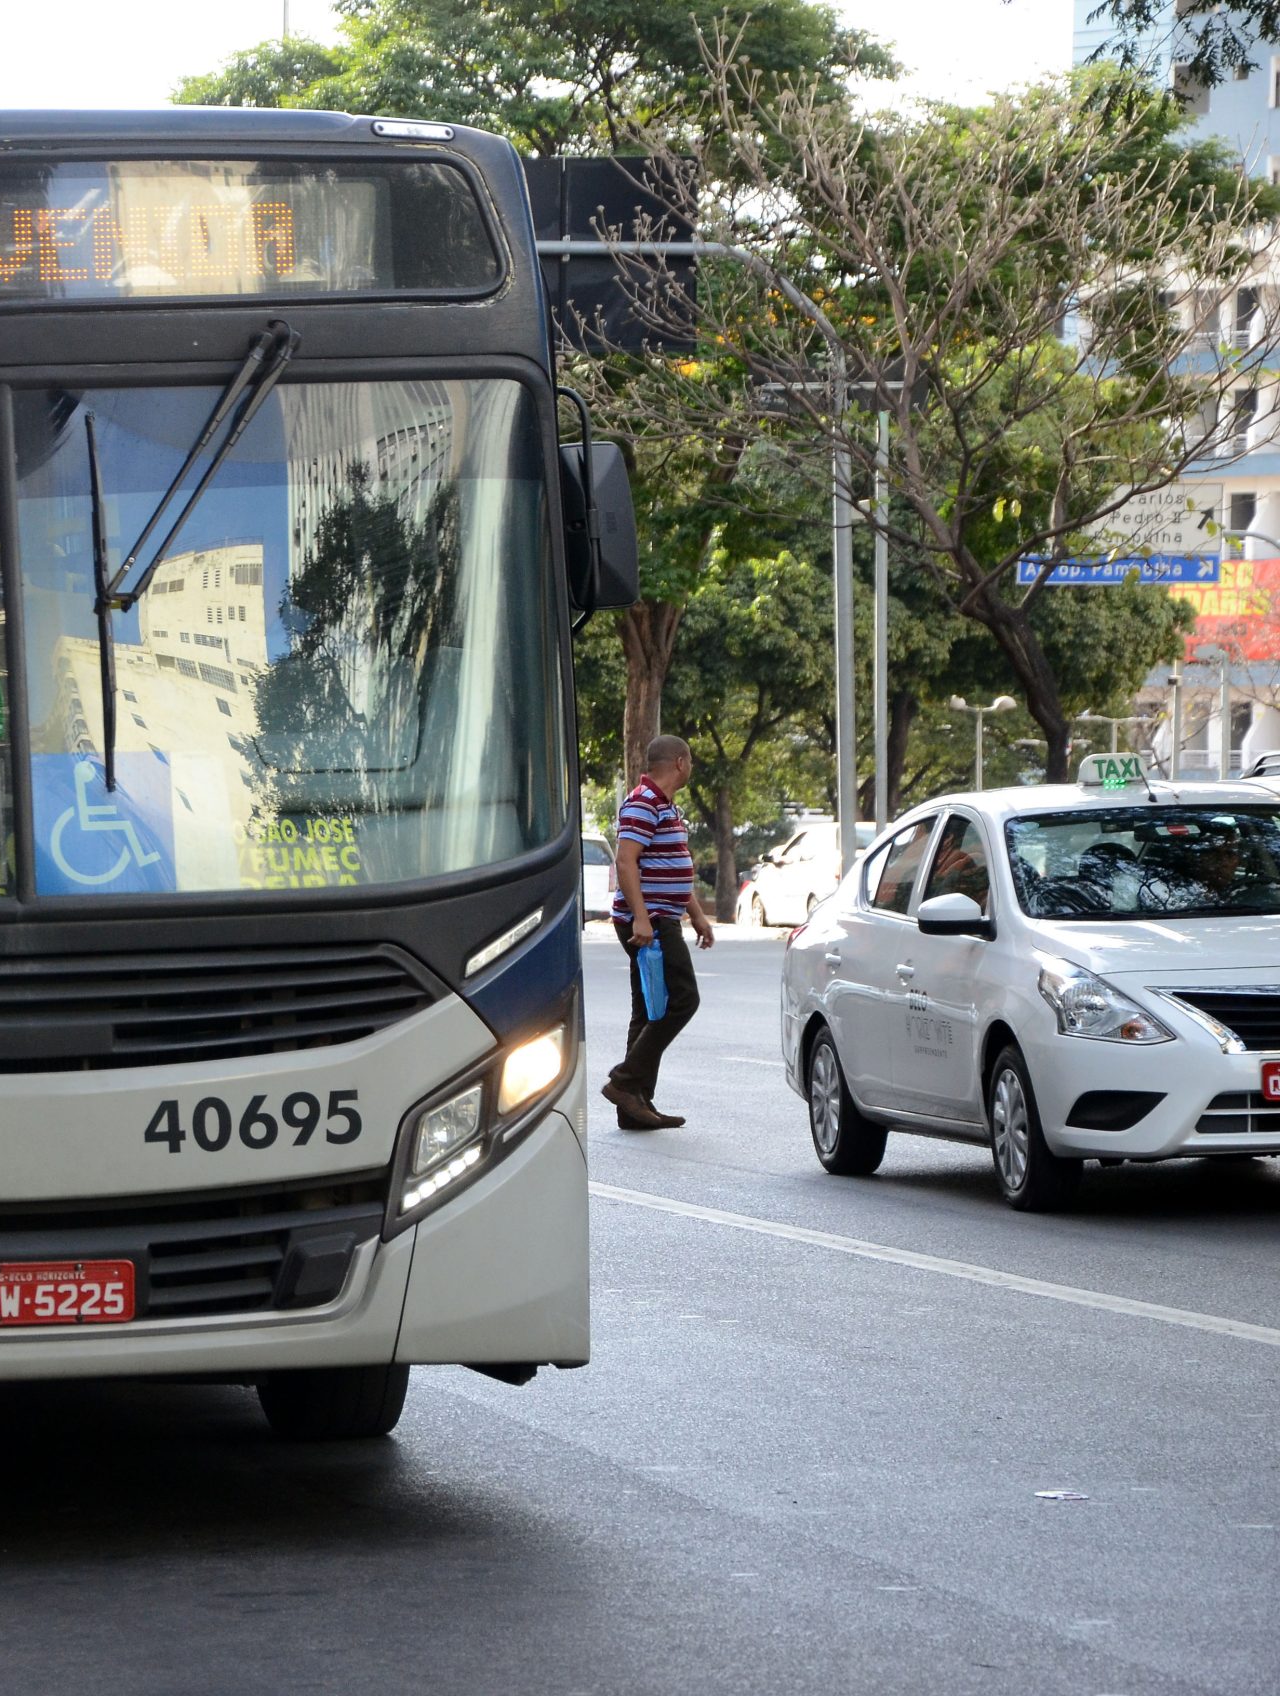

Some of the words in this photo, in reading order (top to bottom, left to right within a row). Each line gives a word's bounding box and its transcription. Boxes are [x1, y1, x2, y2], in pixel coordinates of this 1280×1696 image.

[1110, 509, 1164, 524] Pedro
[1092, 757, 1141, 779] TAXI
[143, 1089, 363, 1154] 40695
